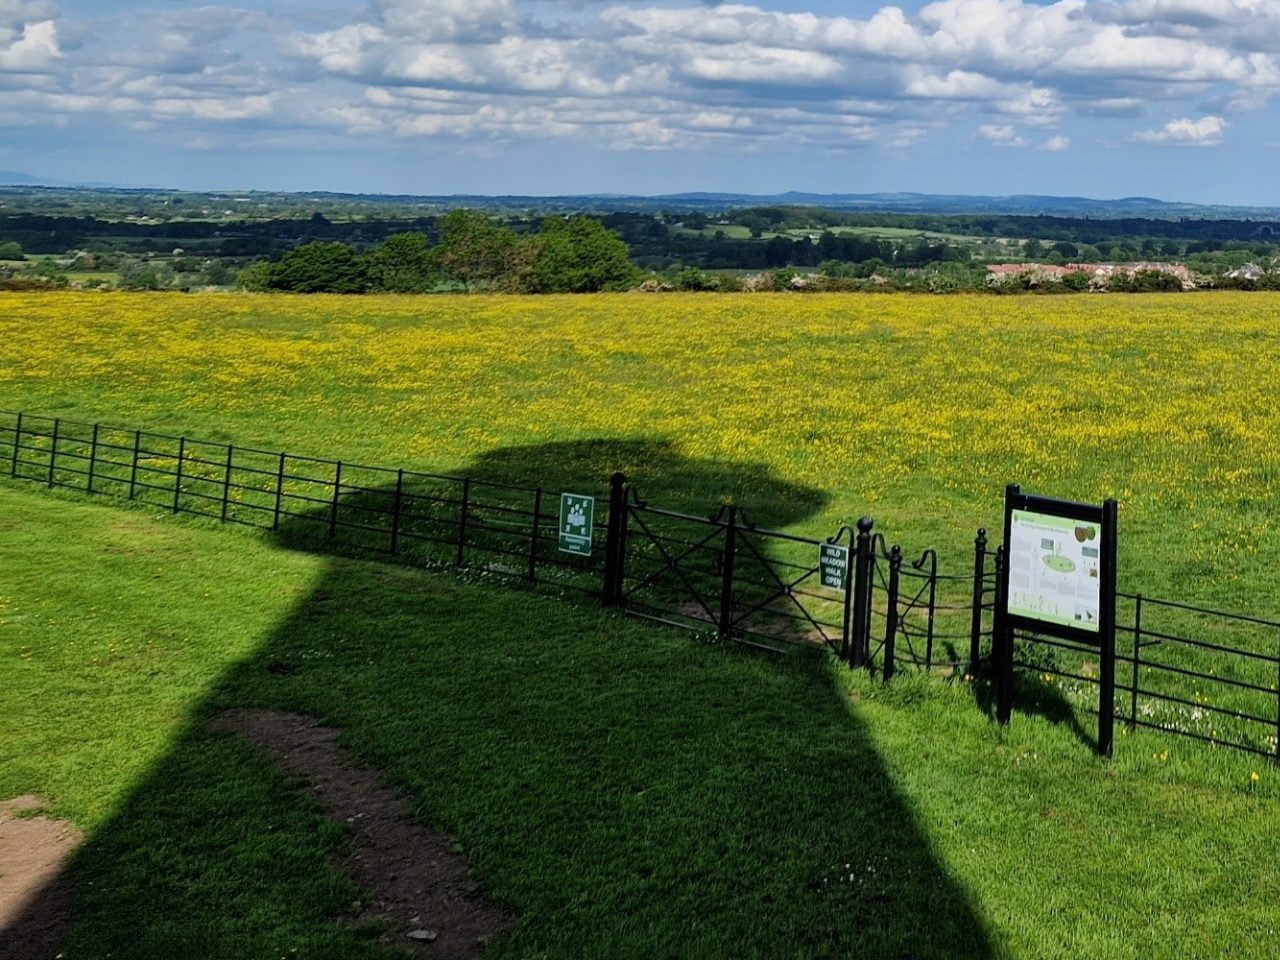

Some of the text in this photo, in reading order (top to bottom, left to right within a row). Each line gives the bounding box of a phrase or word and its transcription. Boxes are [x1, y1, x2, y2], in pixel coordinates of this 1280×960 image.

[826, 548, 841, 558] WILD
[821, 556, 846, 568] MEADOW
[825, 567, 841, 577] WALK
[825, 575, 842, 587] OPEN
